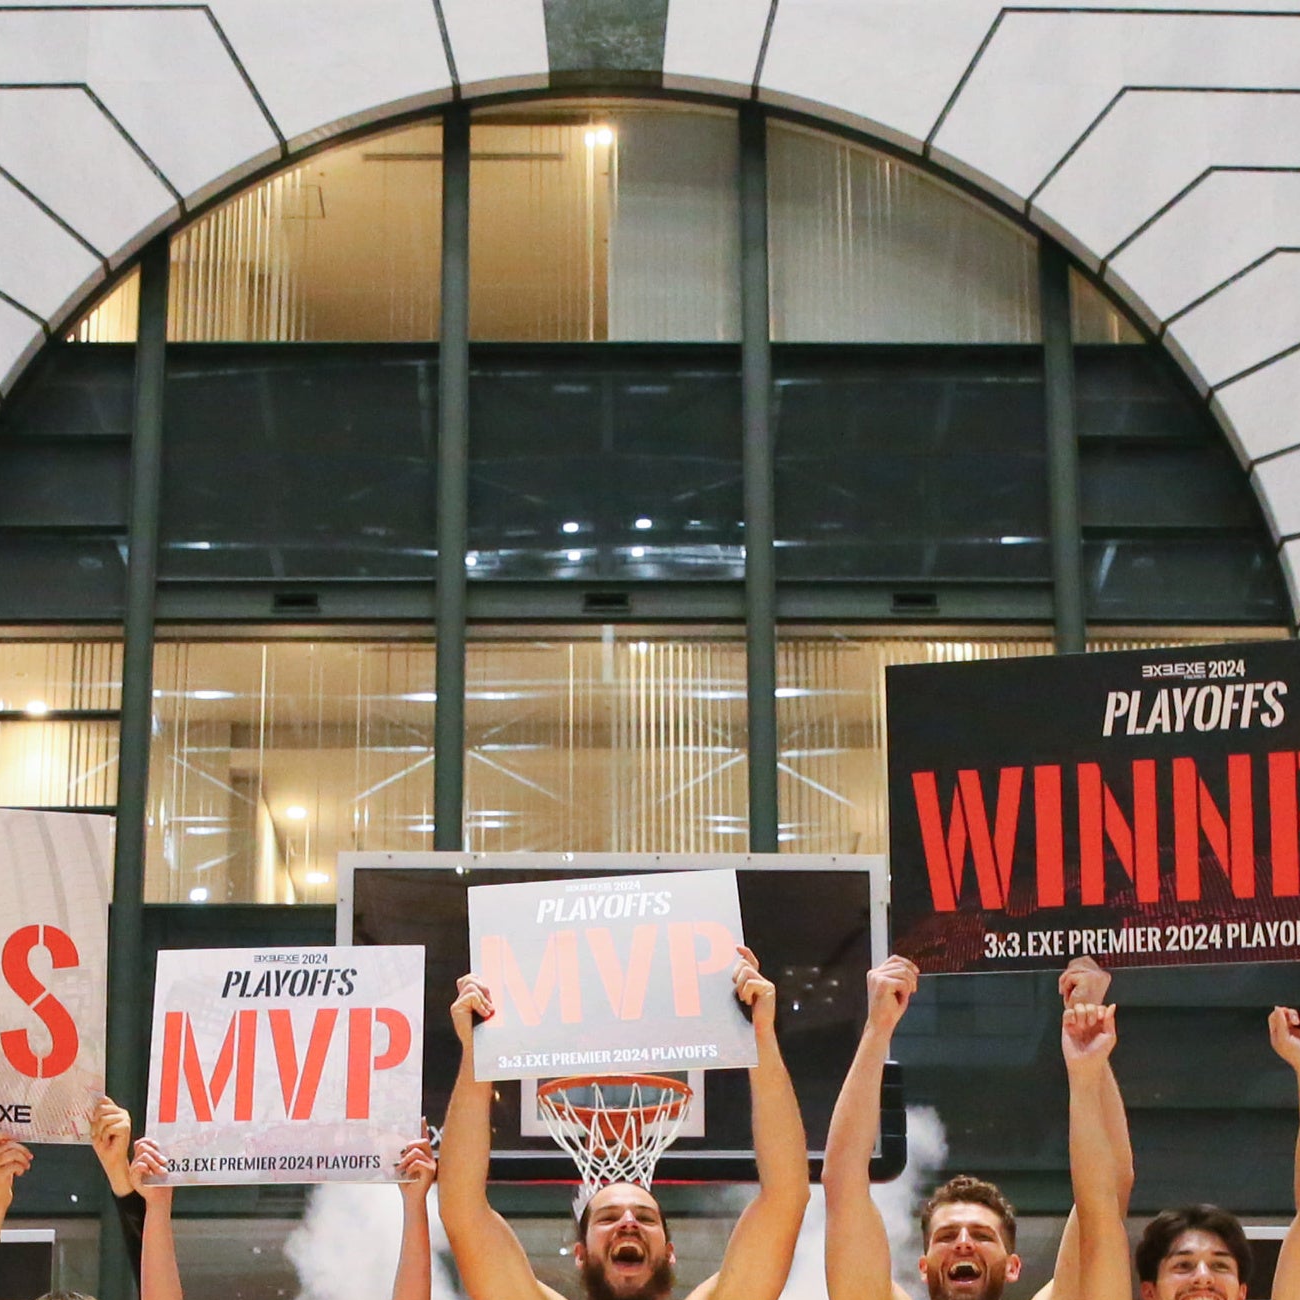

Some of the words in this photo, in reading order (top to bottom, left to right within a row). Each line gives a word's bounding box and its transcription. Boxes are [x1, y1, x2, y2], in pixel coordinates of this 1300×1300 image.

[1208, 659, 1246, 678] 2024
[1103, 681, 1288, 737] PLAYOFFS
[613, 880, 641, 891] 2024
[536, 890, 671, 923] PLAYOFFS
[1069, 926, 1160, 955] PREMIER
[1166, 922, 1223, 951] 2024
[302, 954, 329, 965] 2024
[480, 920, 738, 1029] MVP
[221, 968, 358, 999] PLAYOFFS
[158, 1007, 412, 1123] MVP
[552, 1050, 611, 1066] PREMIER
[613, 1048, 649, 1063] 2024
[651, 1044, 718, 1060] PLAYOFFS
[219, 1156, 276, 1171] PREMIER
[279, 1156, 312, 1170] 2024
[316, 1155, 381, 1169] PLAYOFFS
